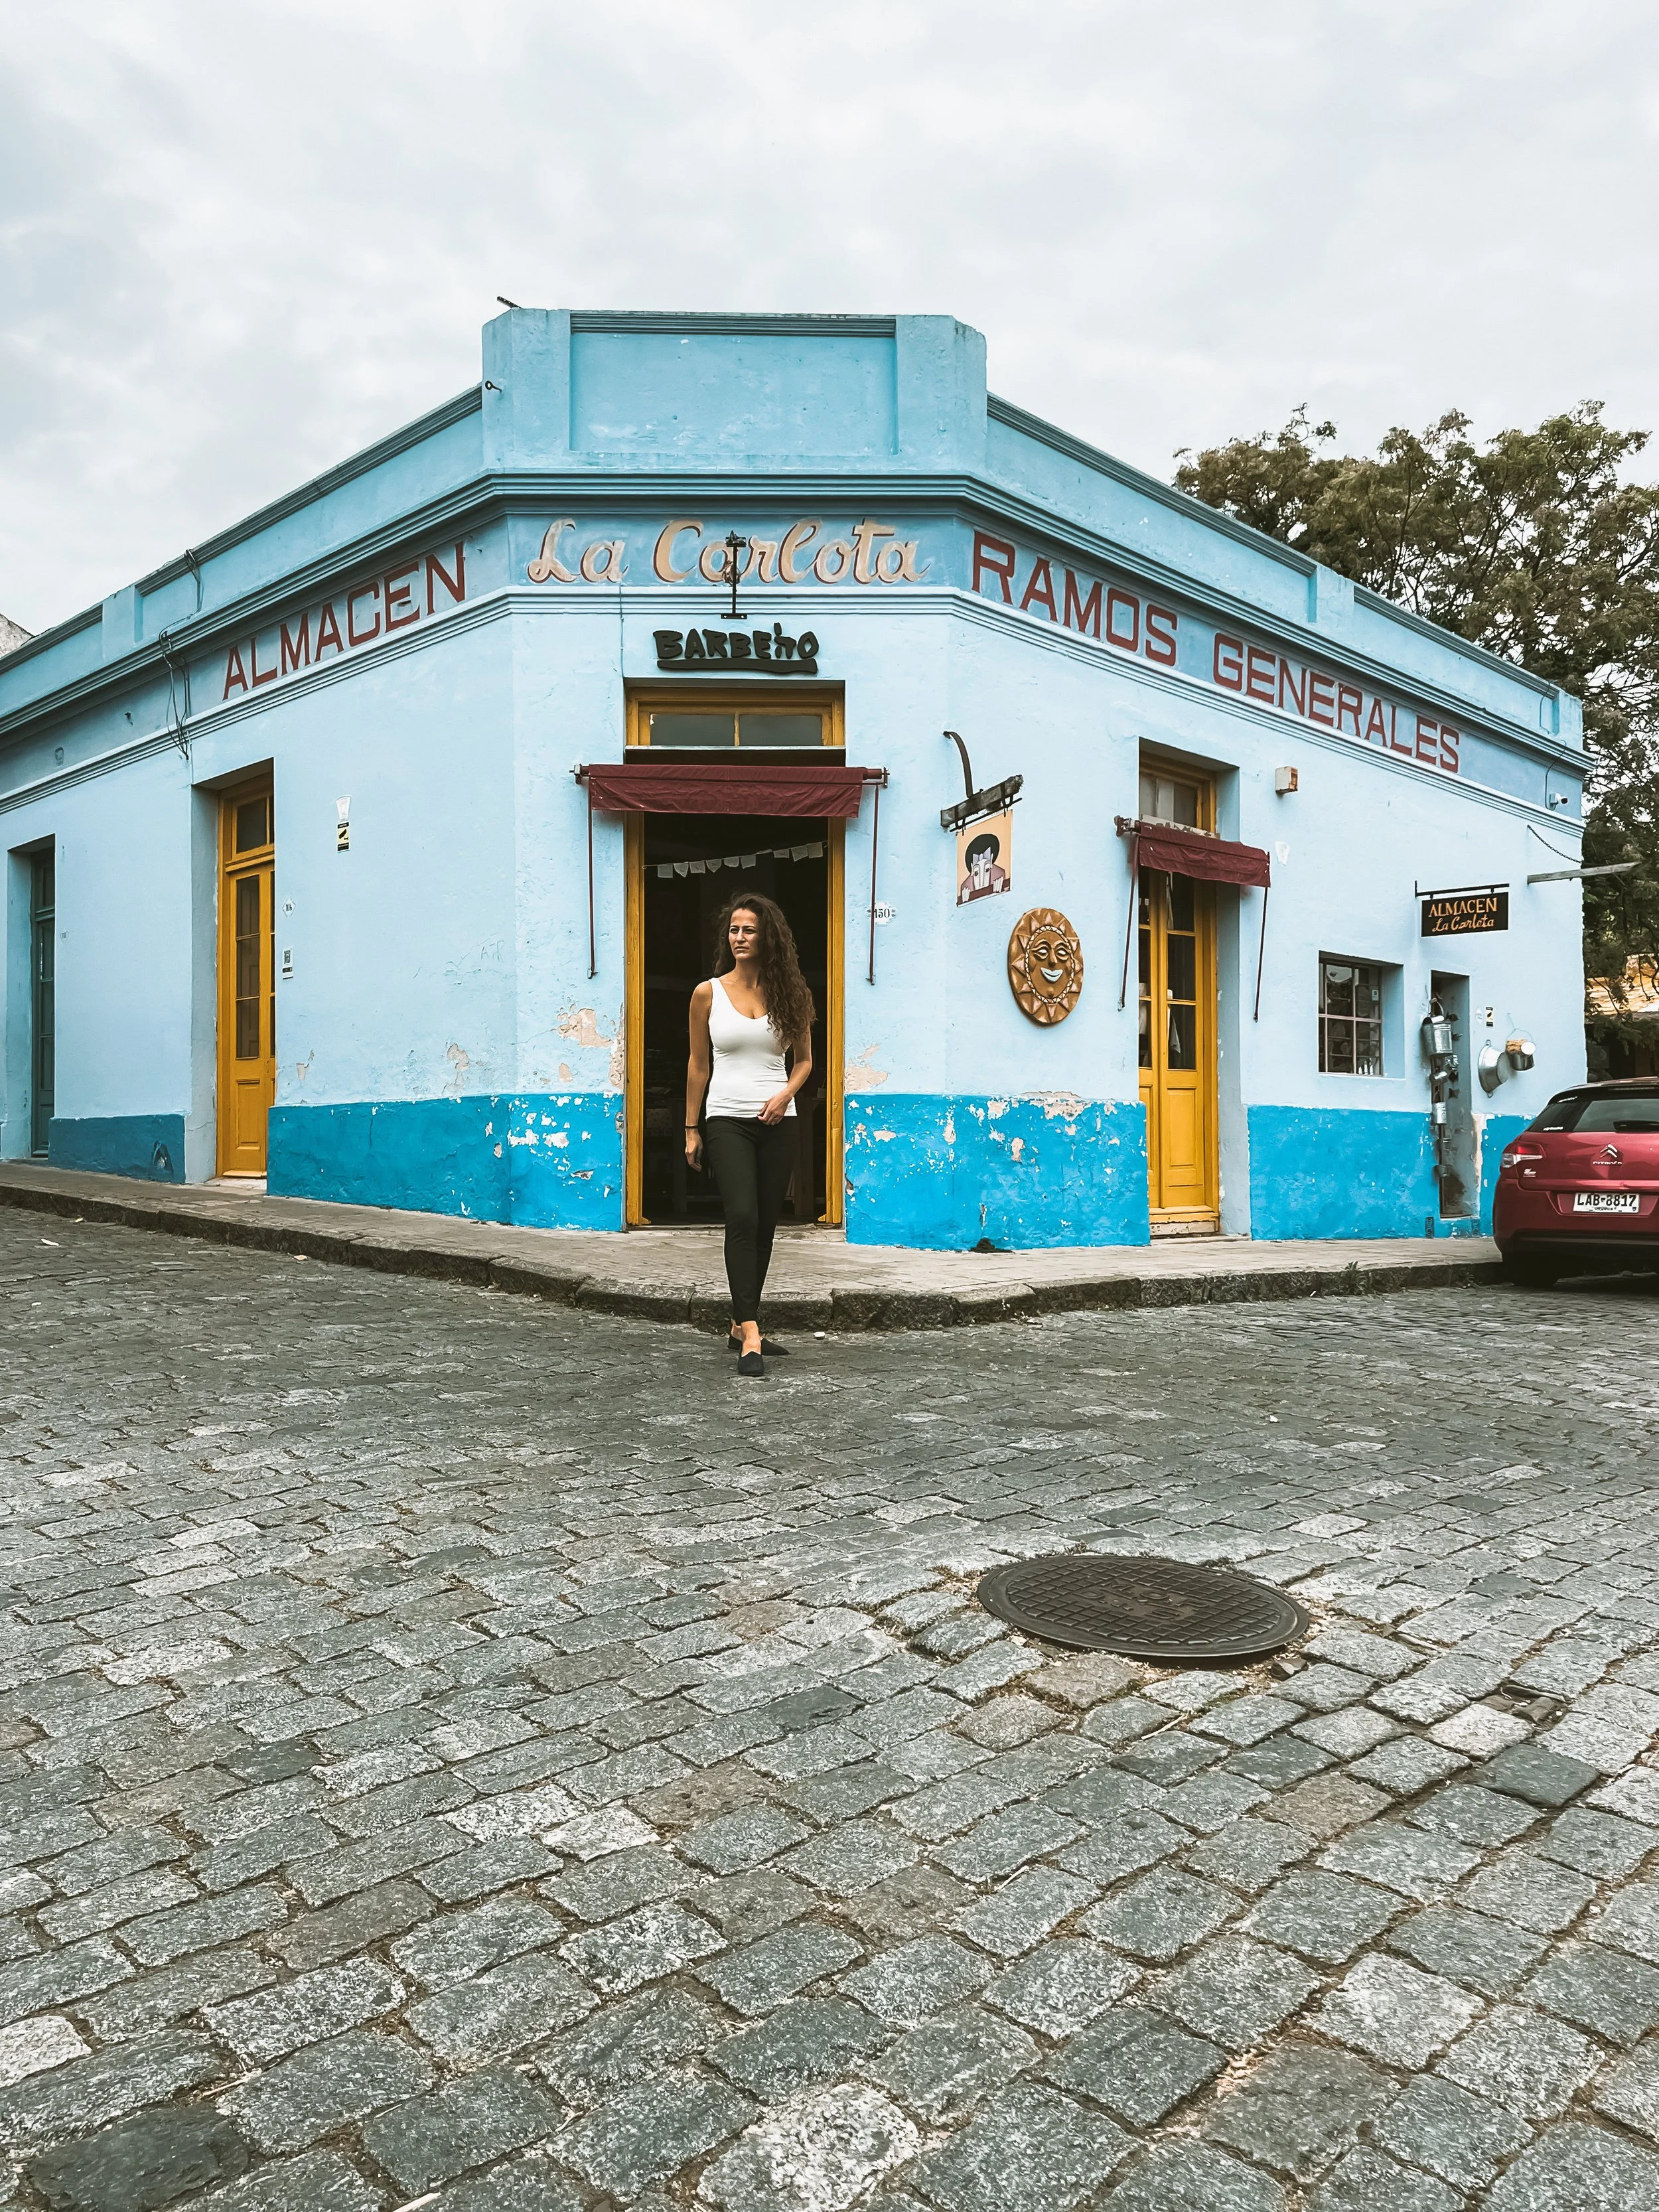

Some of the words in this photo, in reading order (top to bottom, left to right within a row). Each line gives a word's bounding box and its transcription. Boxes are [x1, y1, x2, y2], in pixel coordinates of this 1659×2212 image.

[528, 518, 628, 583] La
[653, 516, 930, 585] Carlota
[223, 540, 465, 700] ALMACEN
[972, 530, 1178, 667] RAMOS
[1213, 632, 1460, 774] GENERALES
[1428, 897, 1498, 917] ALMACEN
[1432, 917, 1449, 932] La
[1451, 914, 1494, 930] Carlota
